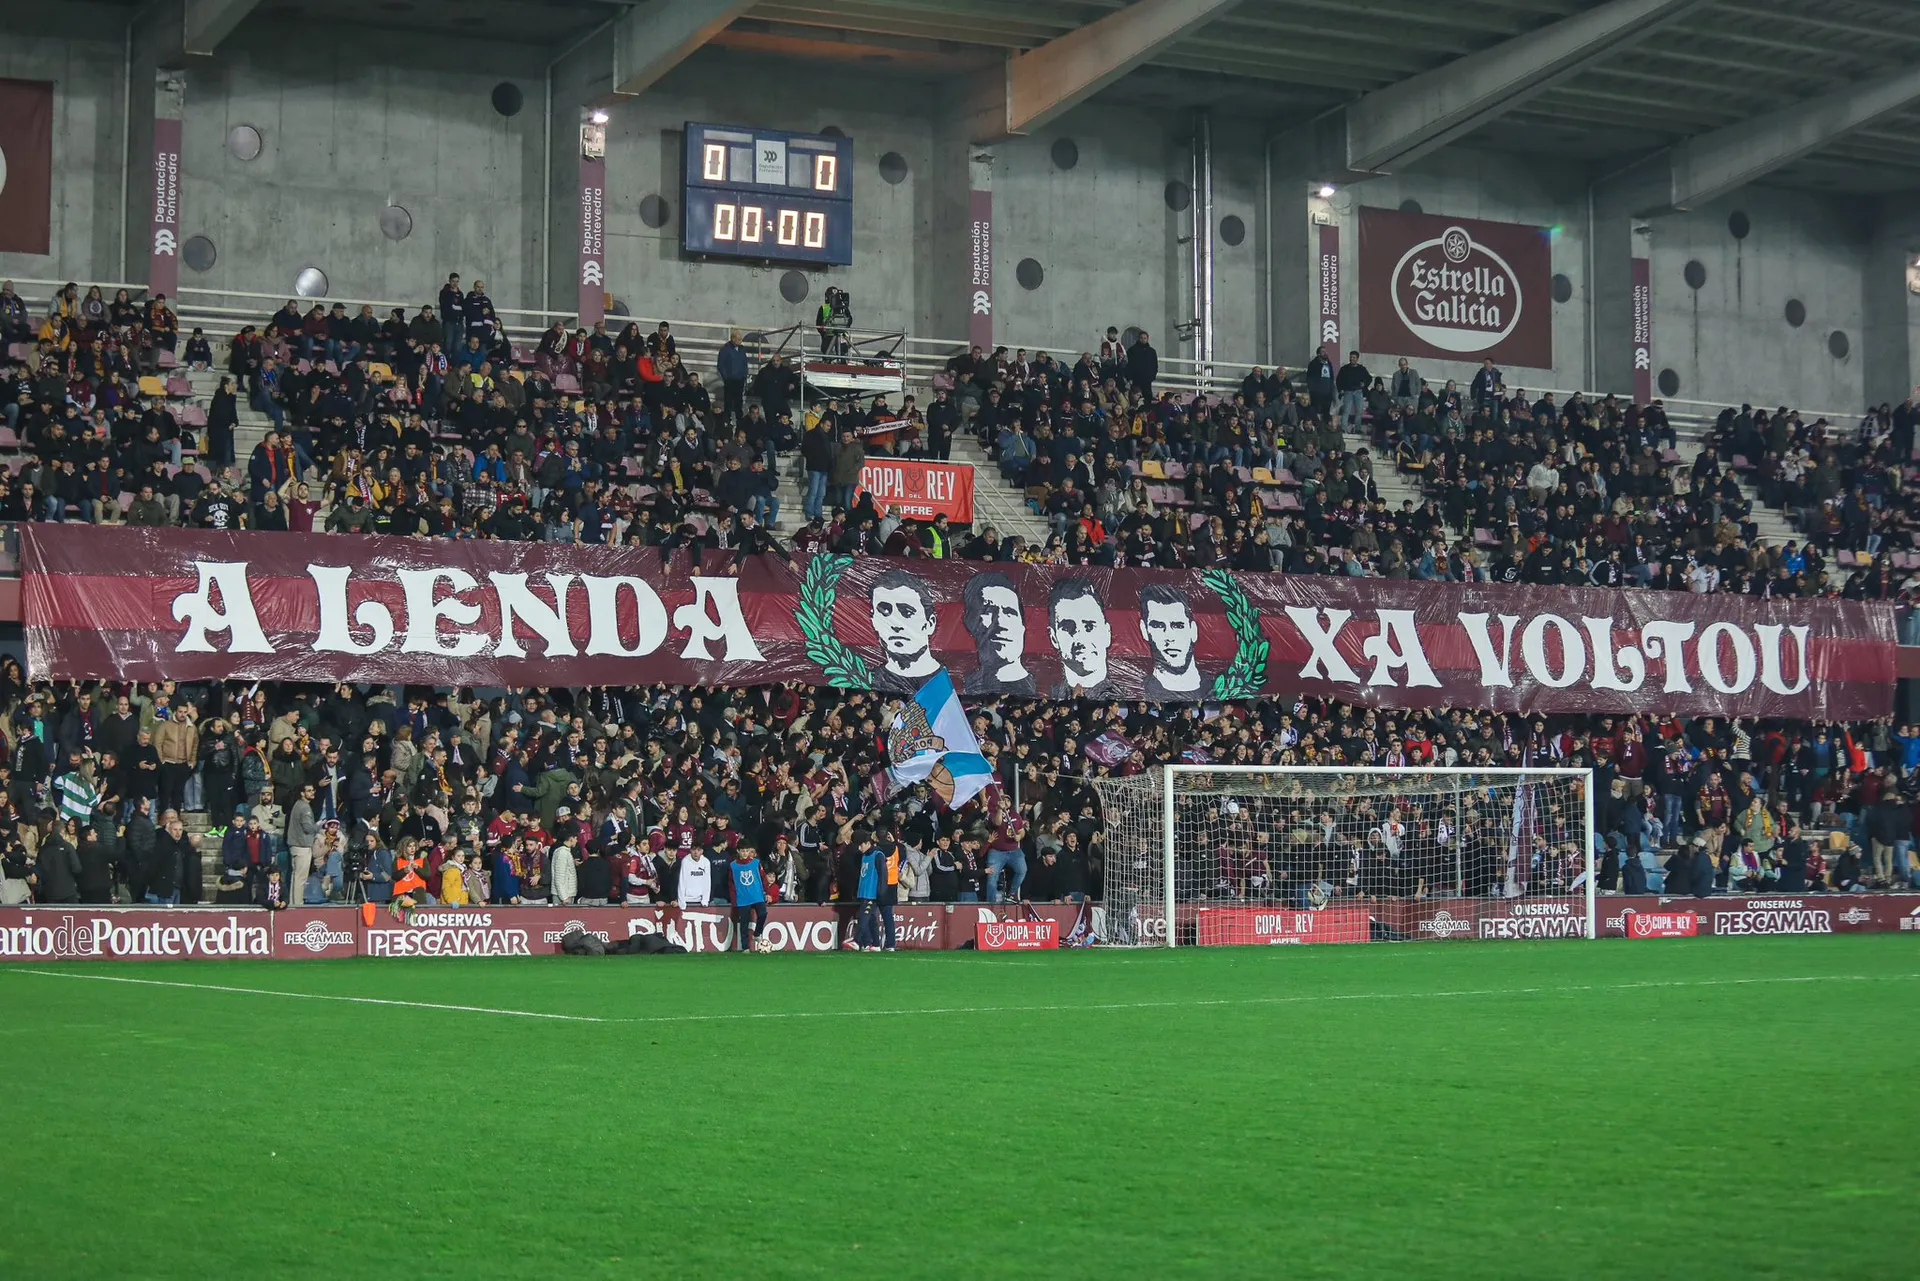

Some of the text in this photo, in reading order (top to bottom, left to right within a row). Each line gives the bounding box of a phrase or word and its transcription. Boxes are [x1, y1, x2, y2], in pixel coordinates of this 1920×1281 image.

[704, 144, 725, 181] 0
[815, 155, 836, 191] 0
[155, 152, 167, 223] Deputación
[166, 153, 177, 224] Pontevedra
[582, 187, 593, 254] Deputación
[593, 188, 602, 255] Pontevedra
[971, 221, 982, 285] Deputación
[981, 222, 989, 286] Pontevedra
[1321, 254, 1331, 315] Deputación
[1330, 255, 1338, 316] Pontevedra
[1410, 259, 1505, 297] Estrella
[1415, 290, 1501, 327] Galicia
[1632, 285, 1642, 343] Deputación
[862, 466, 904, 498] COPA
[927, 469, 955, 500] REY
[172, 562, 1810, 695] A LENDA XA VOLTOU
[1652, 915, 1672, 930] COPA
[1677, 915, 1690, 930] REY
[1715, 910, 1833, 935] PESCAMAR
[1747, 900, 1803, 909] CONSERVAS
[284, 931, 354, 945] PESCAMAR
[368, 929, 531, 956] PESCAMAR
[1006, 925, 1051, 940] COPA REY
[1255, 913, 1314, 935] COPA REY
[1419, 920, 1471, 931] PESCAMAR
